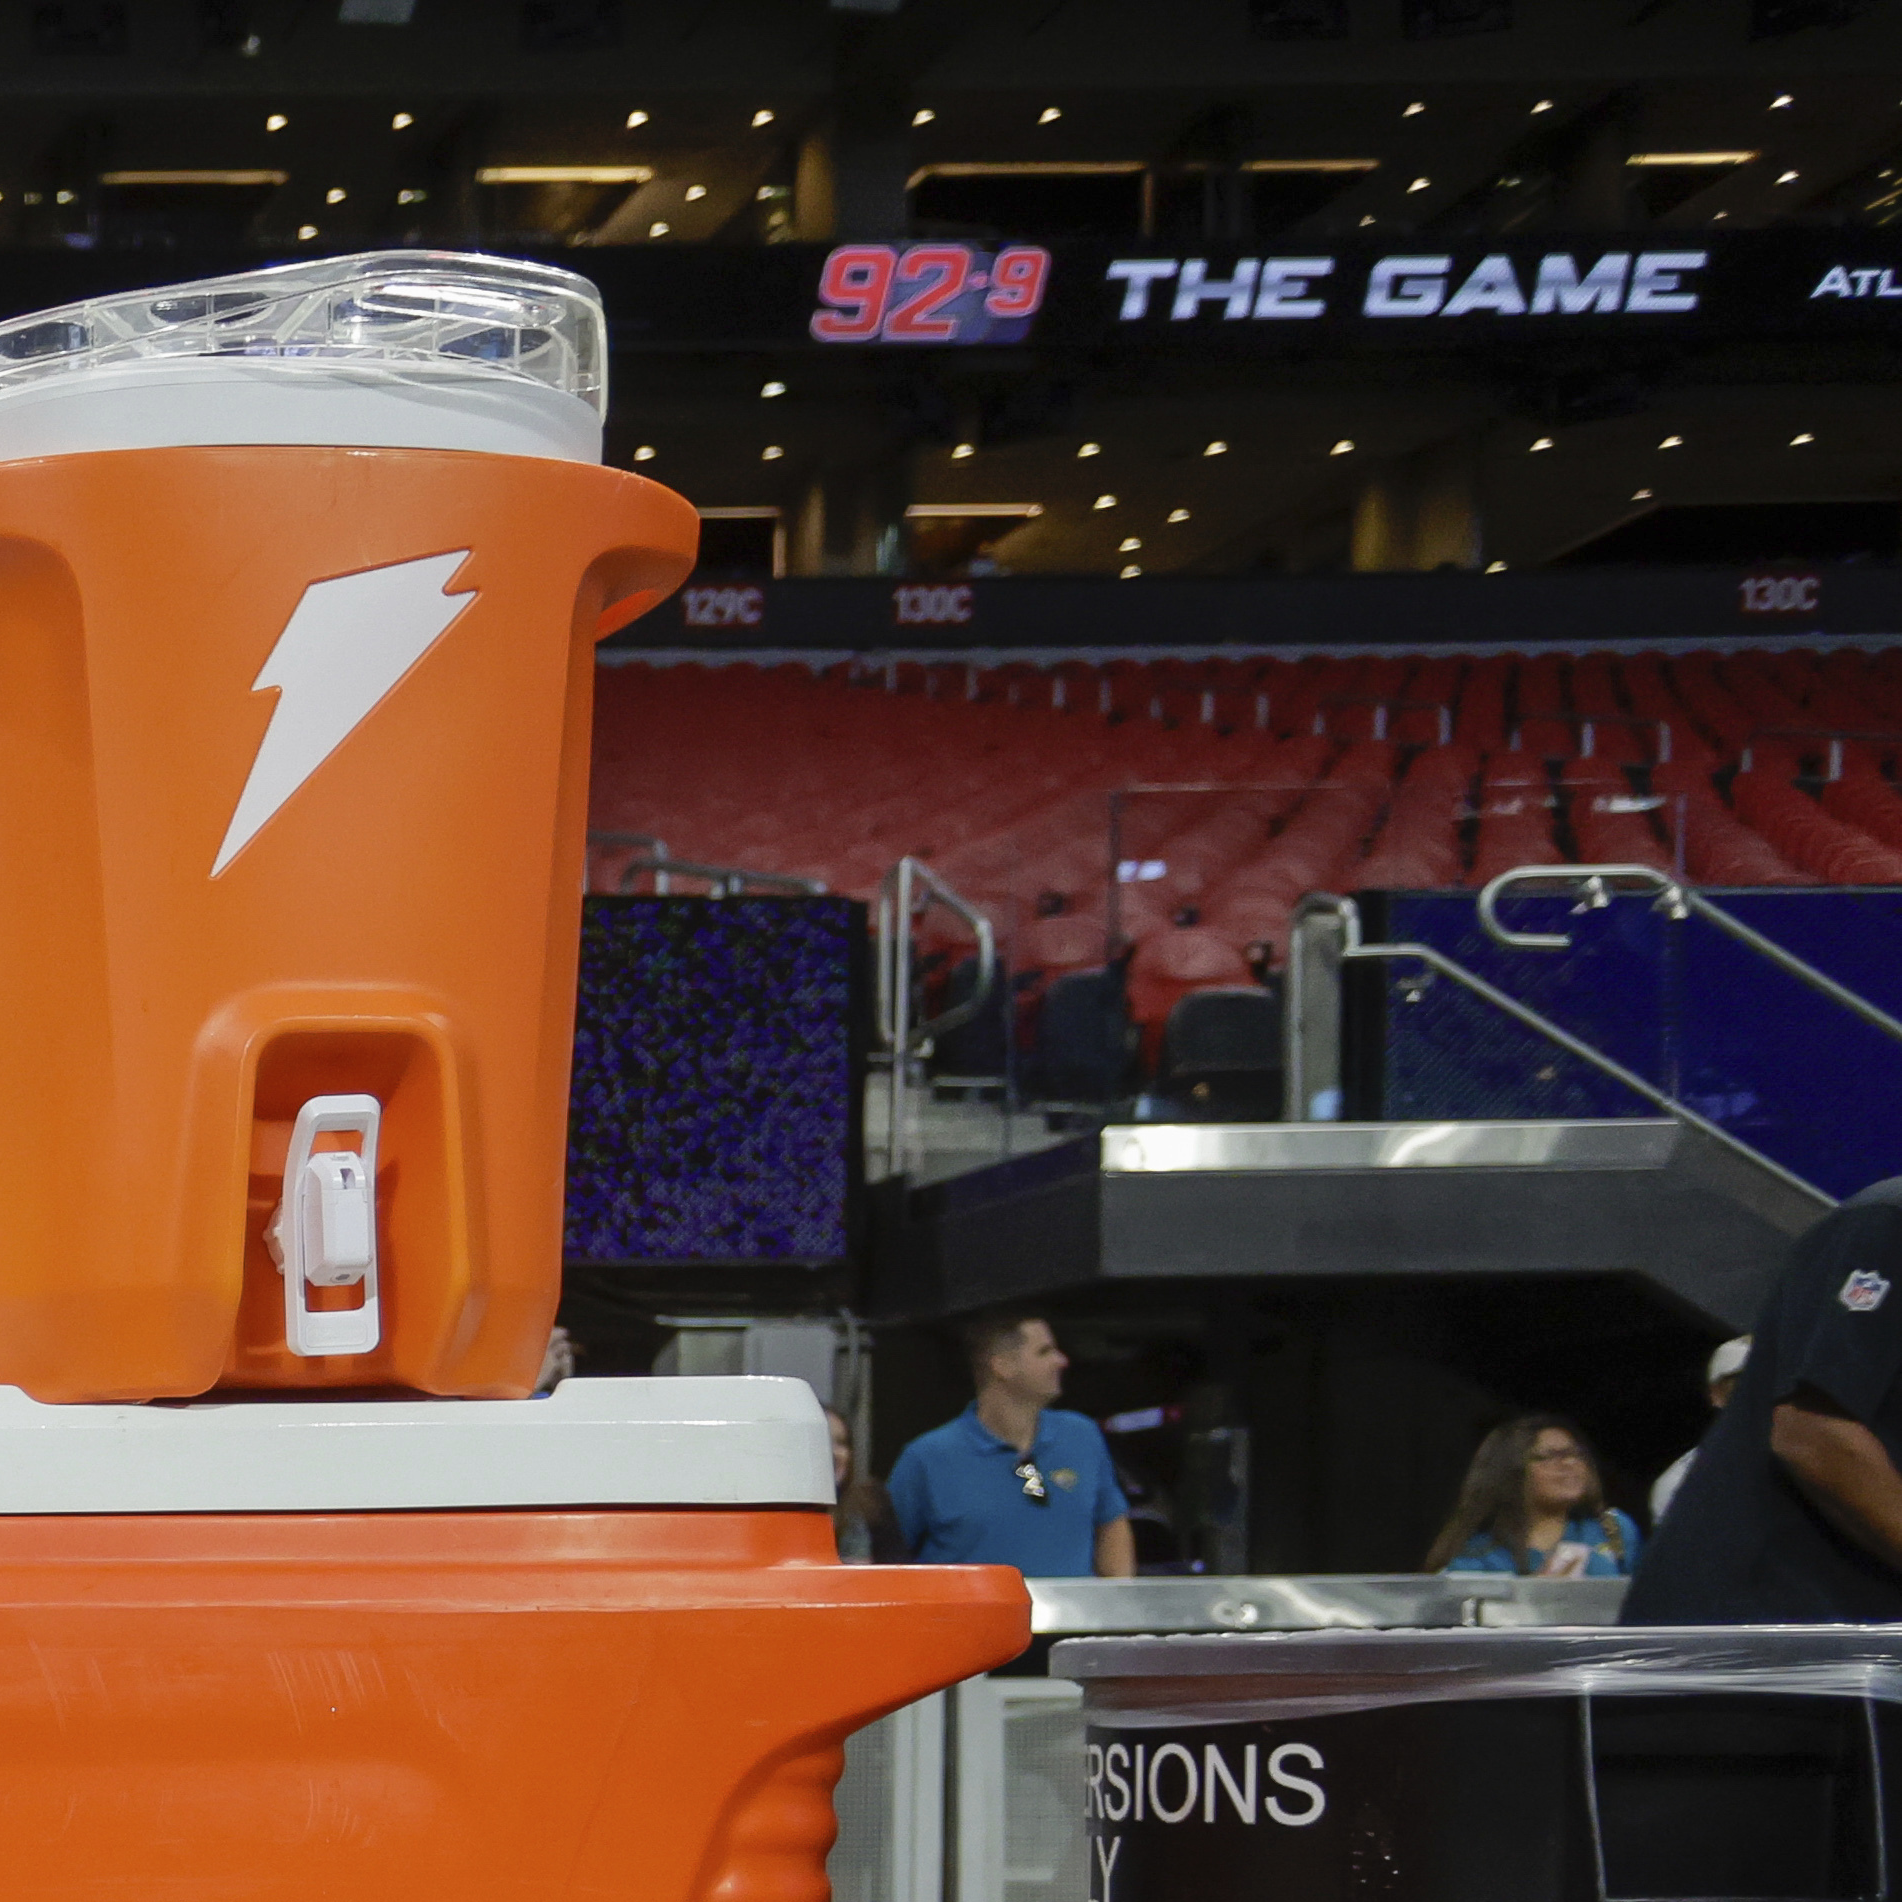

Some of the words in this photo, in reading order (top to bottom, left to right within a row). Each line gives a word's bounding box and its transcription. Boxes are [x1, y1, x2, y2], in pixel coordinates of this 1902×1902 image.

[1106, 257, 1334, 320] THE
[1362, 251, 1707, 317] GAME
[1083, 1742, 1326, 1827] RSIONS
